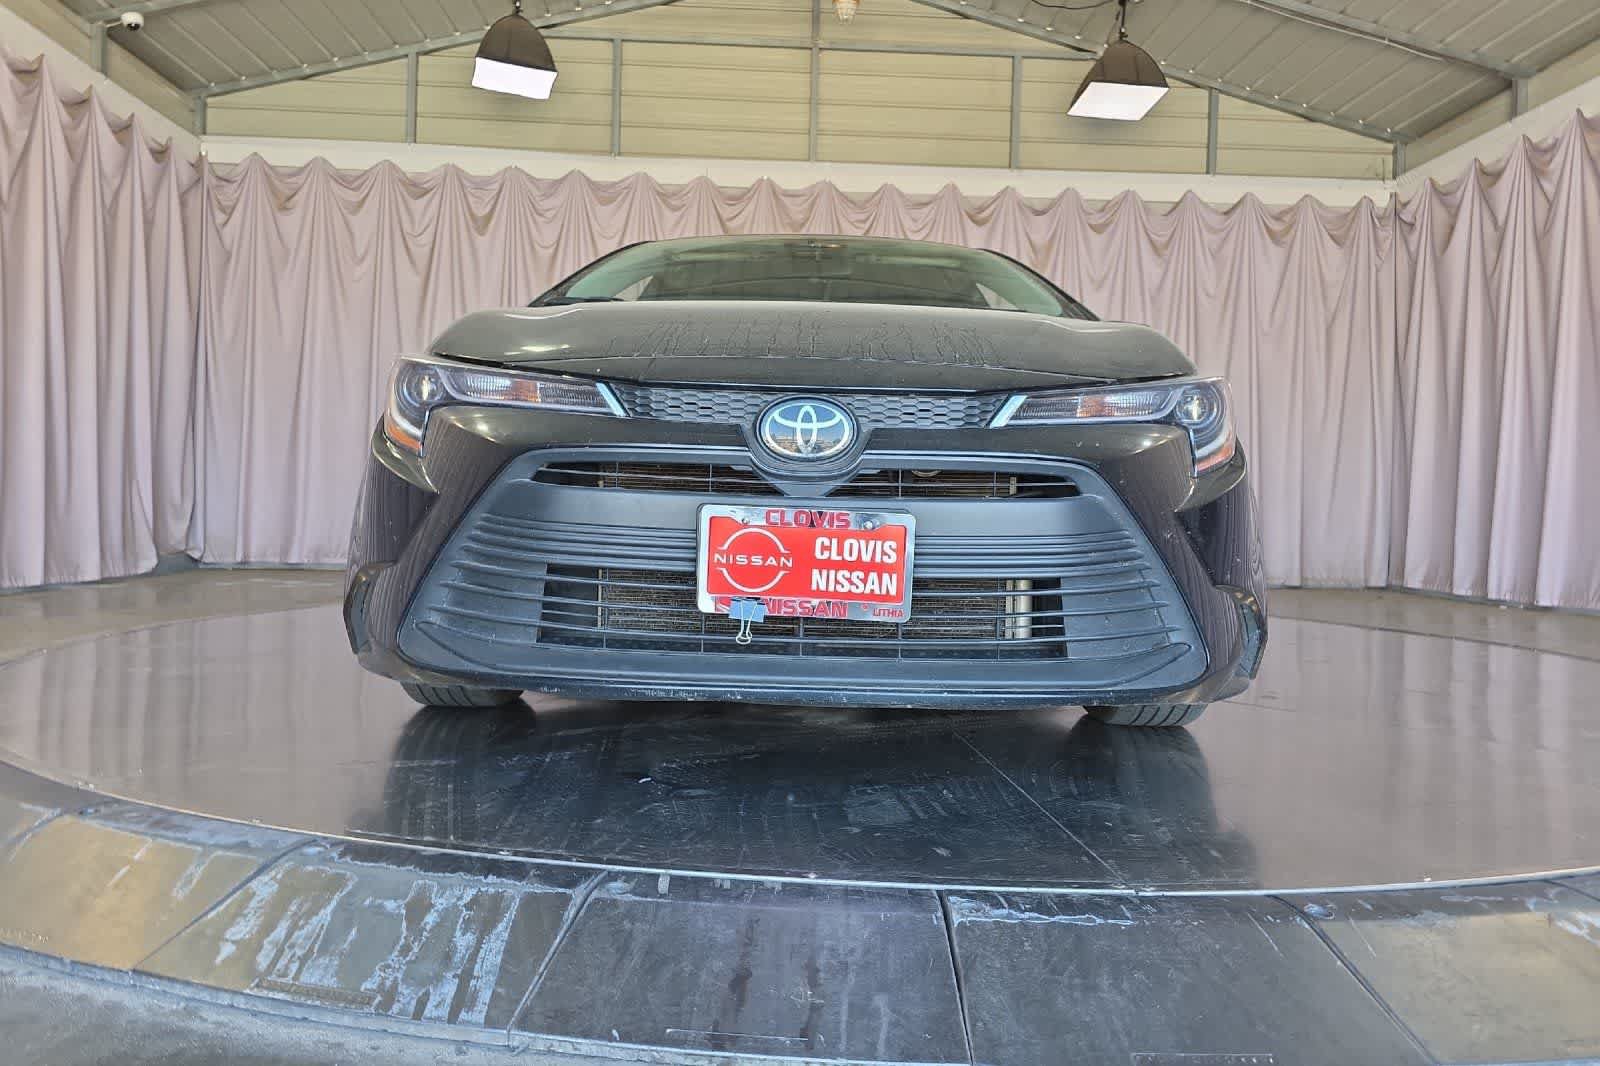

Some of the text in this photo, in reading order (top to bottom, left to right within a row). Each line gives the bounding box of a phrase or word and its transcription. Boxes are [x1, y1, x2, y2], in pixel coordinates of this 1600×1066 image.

[765, 509, 850, 529] CLOVIS
[713, 552, 793, 568] NISSAN
[815, 537, 897, 564] CLOVIS
[811, 569, 897, 597] NISSAN
[766, 597, 848, 618] NISSAN
[872, 607, 904, 618] LITHIA
